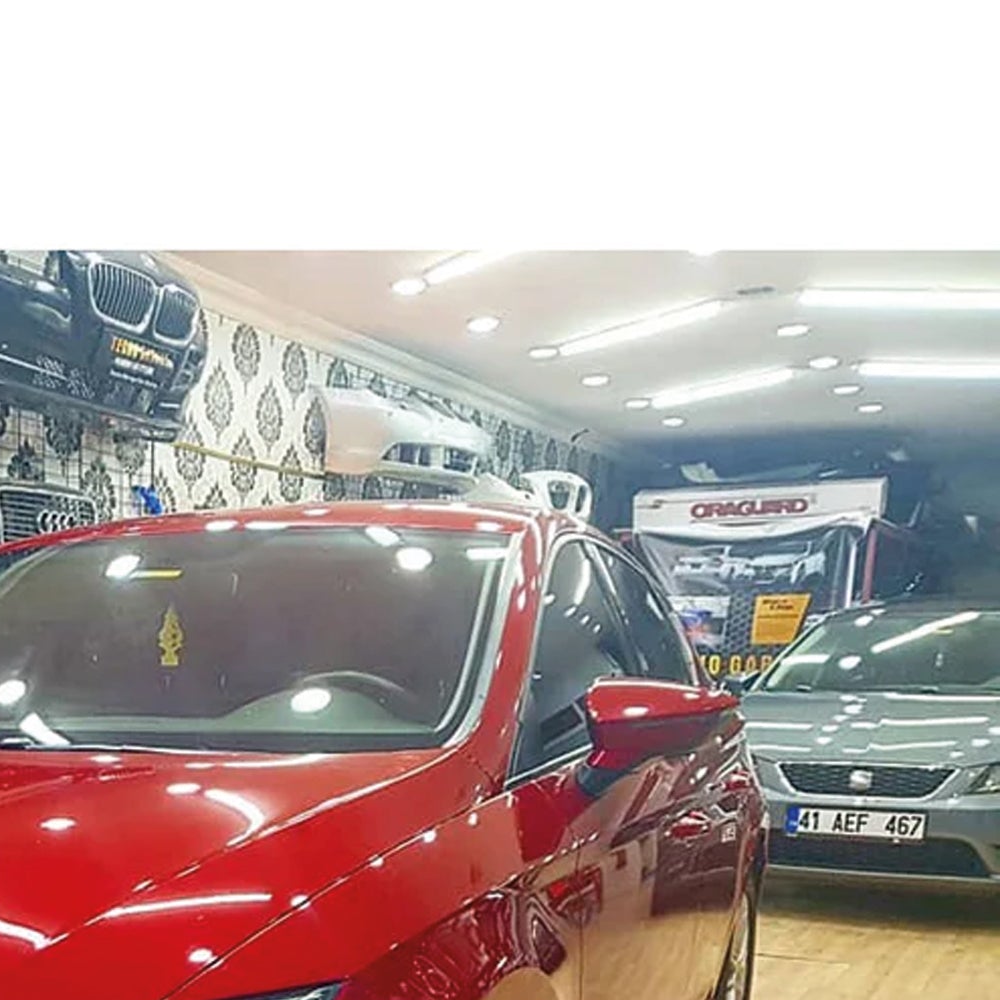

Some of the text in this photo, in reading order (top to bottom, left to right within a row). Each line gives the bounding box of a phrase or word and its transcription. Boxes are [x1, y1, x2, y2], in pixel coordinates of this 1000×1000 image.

[799, 811, 922, 836] 41 AEF 467
